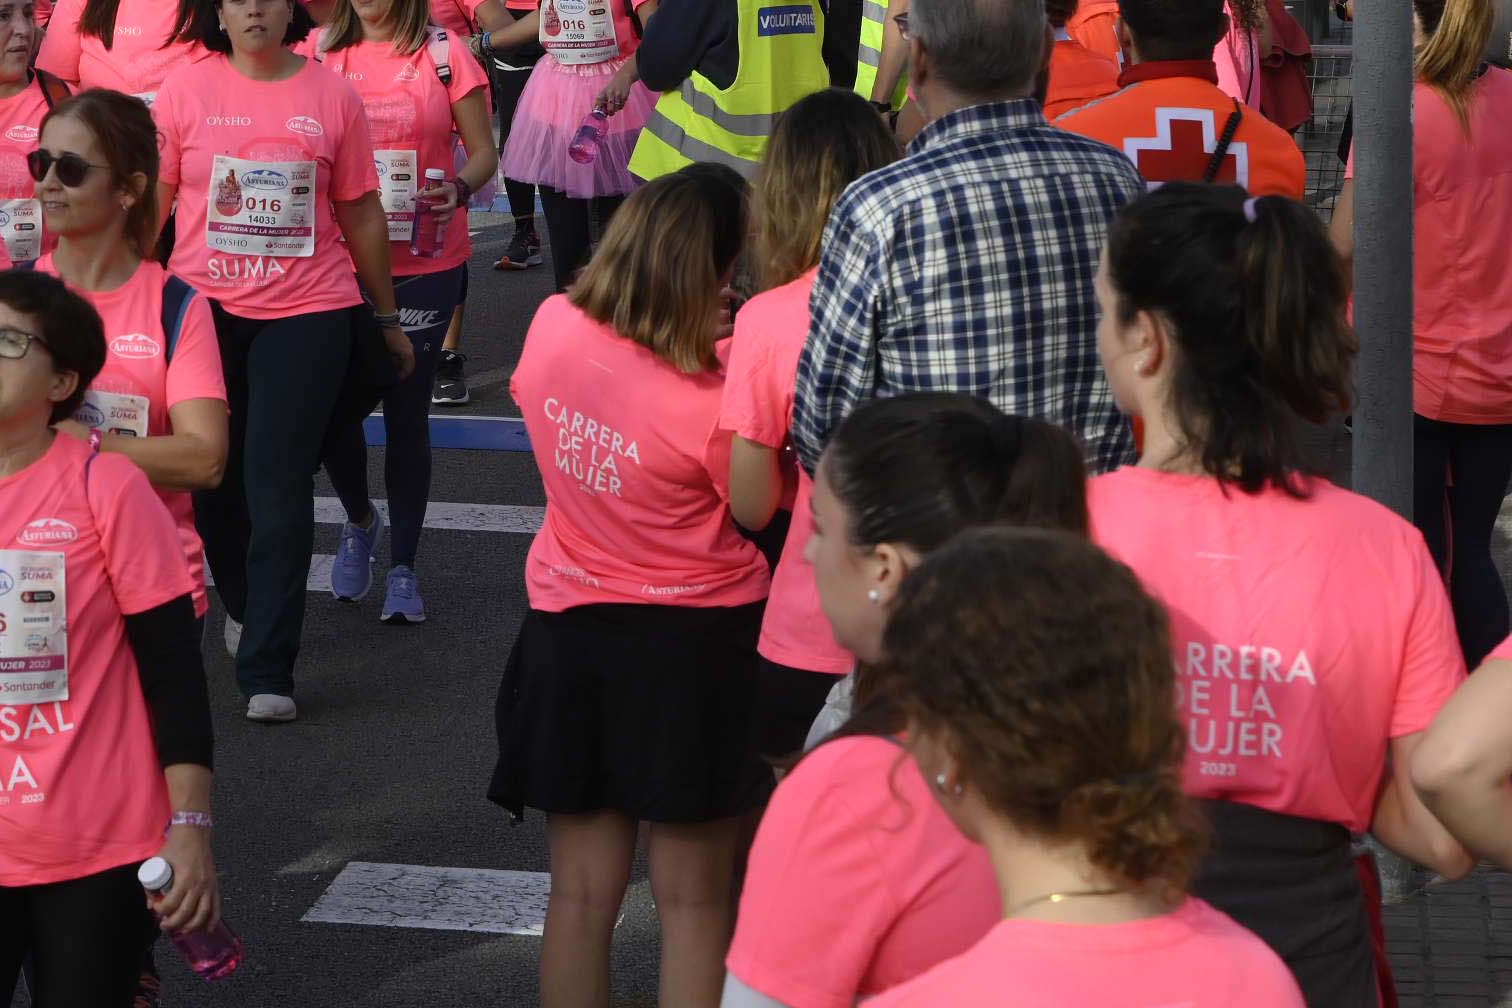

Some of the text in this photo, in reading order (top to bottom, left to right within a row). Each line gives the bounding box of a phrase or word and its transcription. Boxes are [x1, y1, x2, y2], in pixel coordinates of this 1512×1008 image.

[117, 26, 142, 35] SHO
[563, 20, 585, 30] 016
[206, 116, 251, 126] OYSHO
[245, 197, 282, 212] 016
[13, 209, 34, 217] SUMA
[248, 214, 276, 224] 14033
[219, 224, 248, 233] CARRERA
[216, 237, 248, 248] OYSHO
[208, 256, 285, 281] SUMA
[399, 308, 439, 324] NIKE
[110, 411, 137, 421] SUMA
[544, 397, 640, 465] CARRERA
[559, 428, 617, 475] DE LA
[23, 529, 73, 540] ASTURIANA
[21, 571, 54, 580] SUMA
[4, 680, 56, 692] Santander
[1230, 683, 1276, 719] LA
[1188, 718, 1283, 758] UJER
